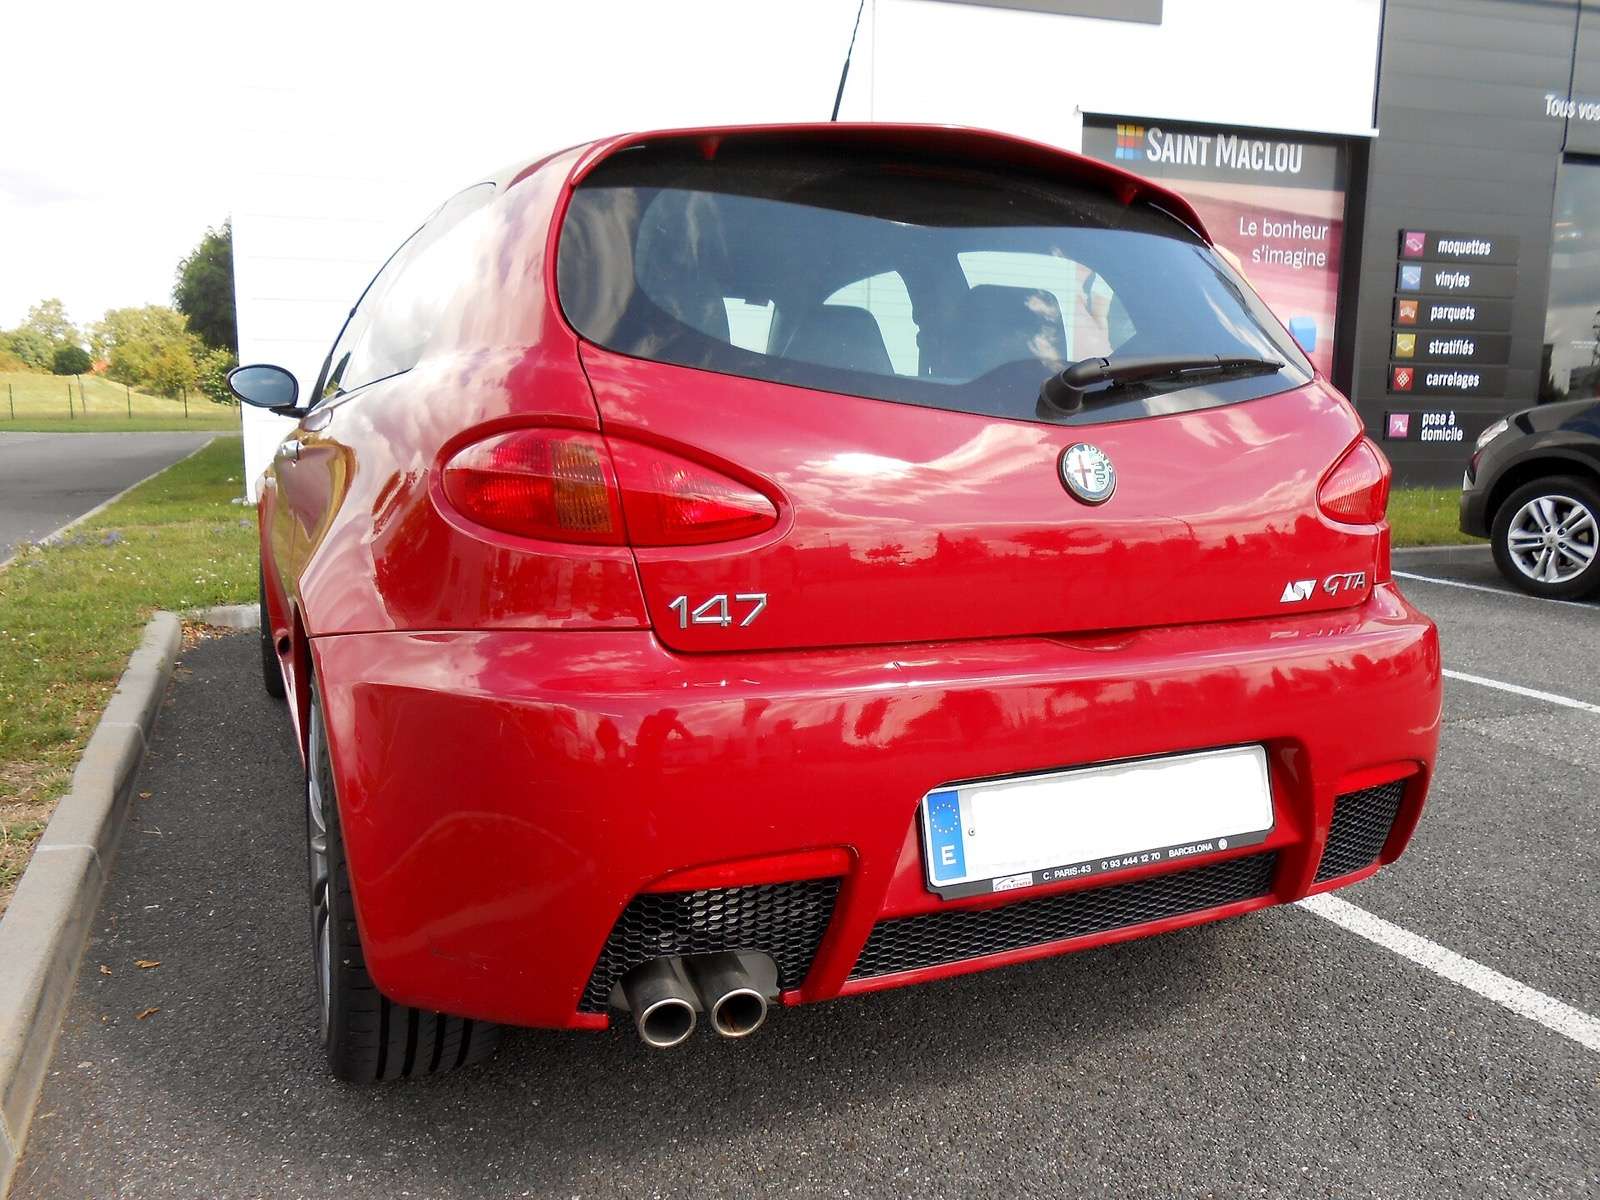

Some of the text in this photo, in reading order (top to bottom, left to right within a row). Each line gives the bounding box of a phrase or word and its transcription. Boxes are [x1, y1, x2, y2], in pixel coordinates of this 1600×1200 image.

[1544, 94, 1576, 119] Tous
[1146, 127, 1303, 174] SAINT MACLOU
[1239, 216, 1328, 241] Le bonheur
[1252, 246, 1326, 269] s'imagine
[1437, 239, 1491, 257] moquettes
[1435, 271, 1471, 289] vinyles
[1430, 305, 1476, 322] parquets
[1428, 339, 1474, 356] stratifiés
[1426, 371, 1480, 389] carrelages
[1422, 410, 1456, 427] pose à
[1421, 426, 1464, 441] domicile
[1323, 571, 1366, 597] GTA
[668, 592, 768, 629] 147
[940, 844, 957, 866] E
[1109, 859, 1121, 869] 93
[1122, 855, 1139, 867] 444
[1140, 853, 1150, 863] 12
[1150, 851, 1161, 862] 70
[1168, 842, 1213, 858] BARCELONA
